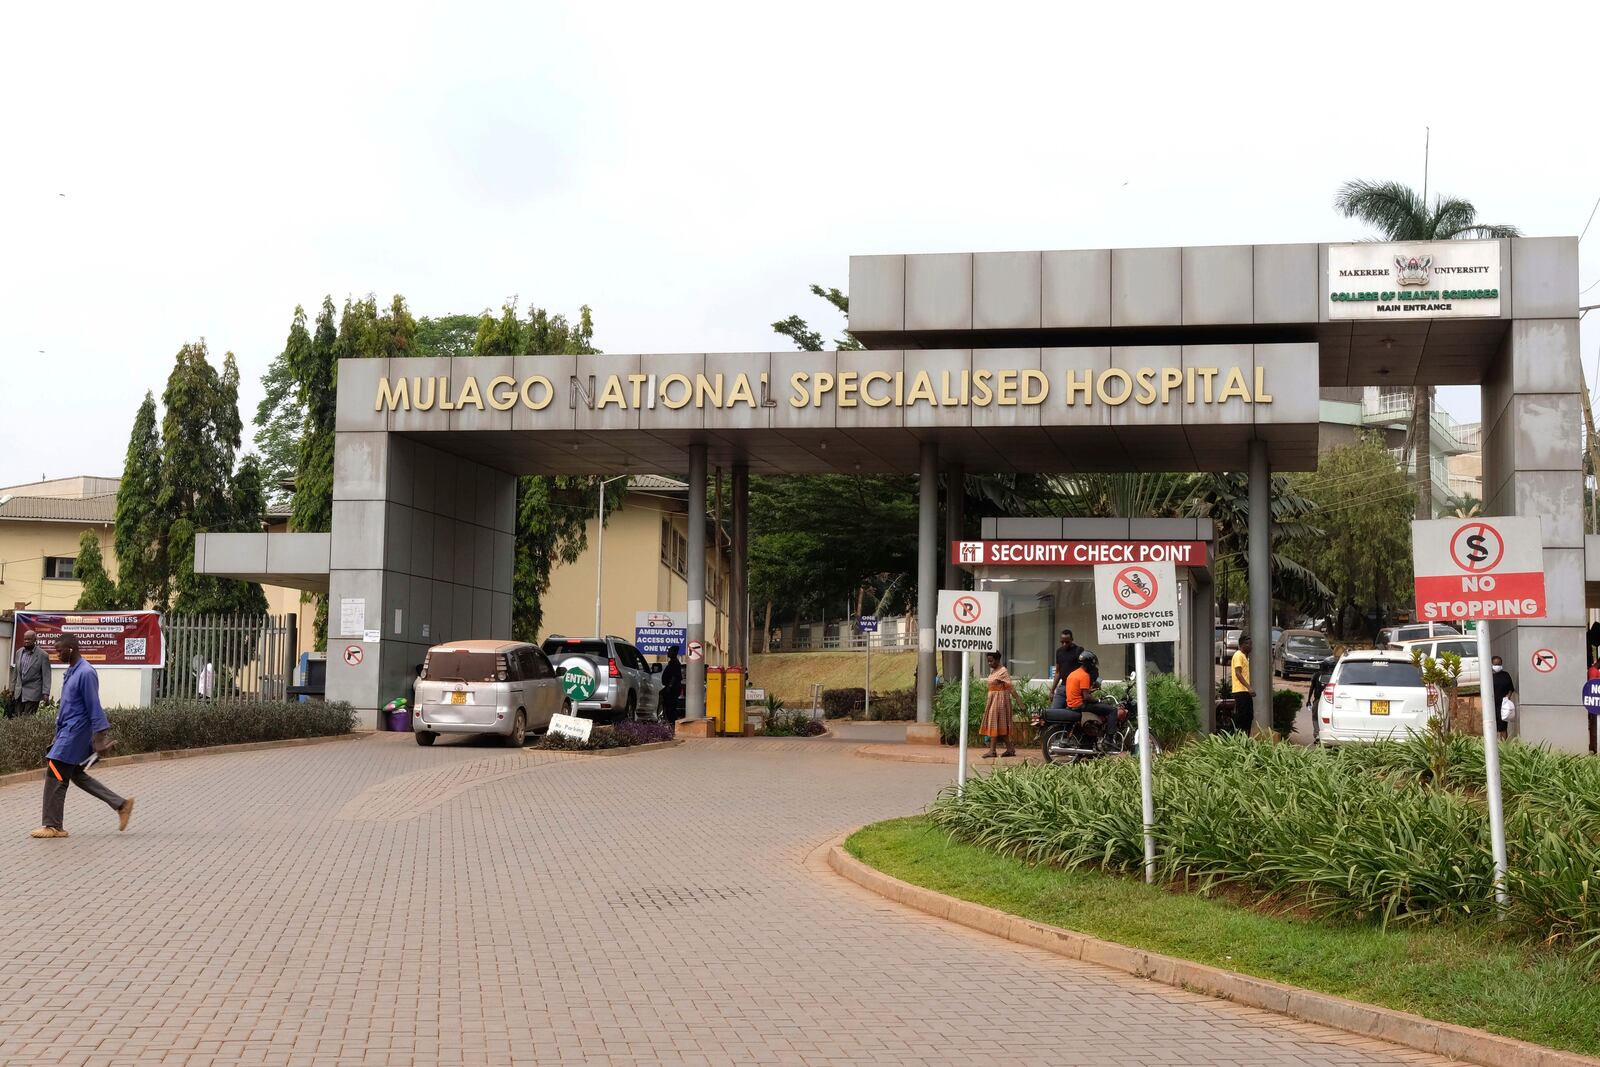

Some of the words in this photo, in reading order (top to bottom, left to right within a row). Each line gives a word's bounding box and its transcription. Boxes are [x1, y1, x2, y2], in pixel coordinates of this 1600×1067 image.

[1434, 266, 1490, 274] UNIVERSITY
[1330, 291, 1378, 302] COLLEGE
[1380, 291, 1396, 301] OF
[1398, 290, 1439, 301] HEALTH
[1442, 289, 1498, 300] SCIENCES
[375, 375, 554, 411] MULAGO
[569, 372, 777, 410] NATIONAL
[789, 370, 1050, 408] SPECIALISED
[1066, 366, 1273, 406] HOSPITAL
[991, 544, 1070, 561] SECURITY
[1073, 544, 1134, 561] CHECK
[1139, 544, 1192, 562] POINT
[1461, 576, 1496, 593] NO
[1423, 598, 1538, 618] STOPPING
[1114, 610, 1174, 620] MOTORCYCLES
[940, 624, 953, 635] NO
[954, 625, 992, 636] PARKING
[1102, 622, 1140, 630] ALLOWED
[1141, 620, 1174, 629] BEYOND
[638, 628, 683, 636] AMBULANCE
[1136, 630, 1161, 638] POINT
[938, 638, 951, 648] NO
[951, 639, 993, 650] STOPPING
[565, 672, 593, 686] ENTRY
